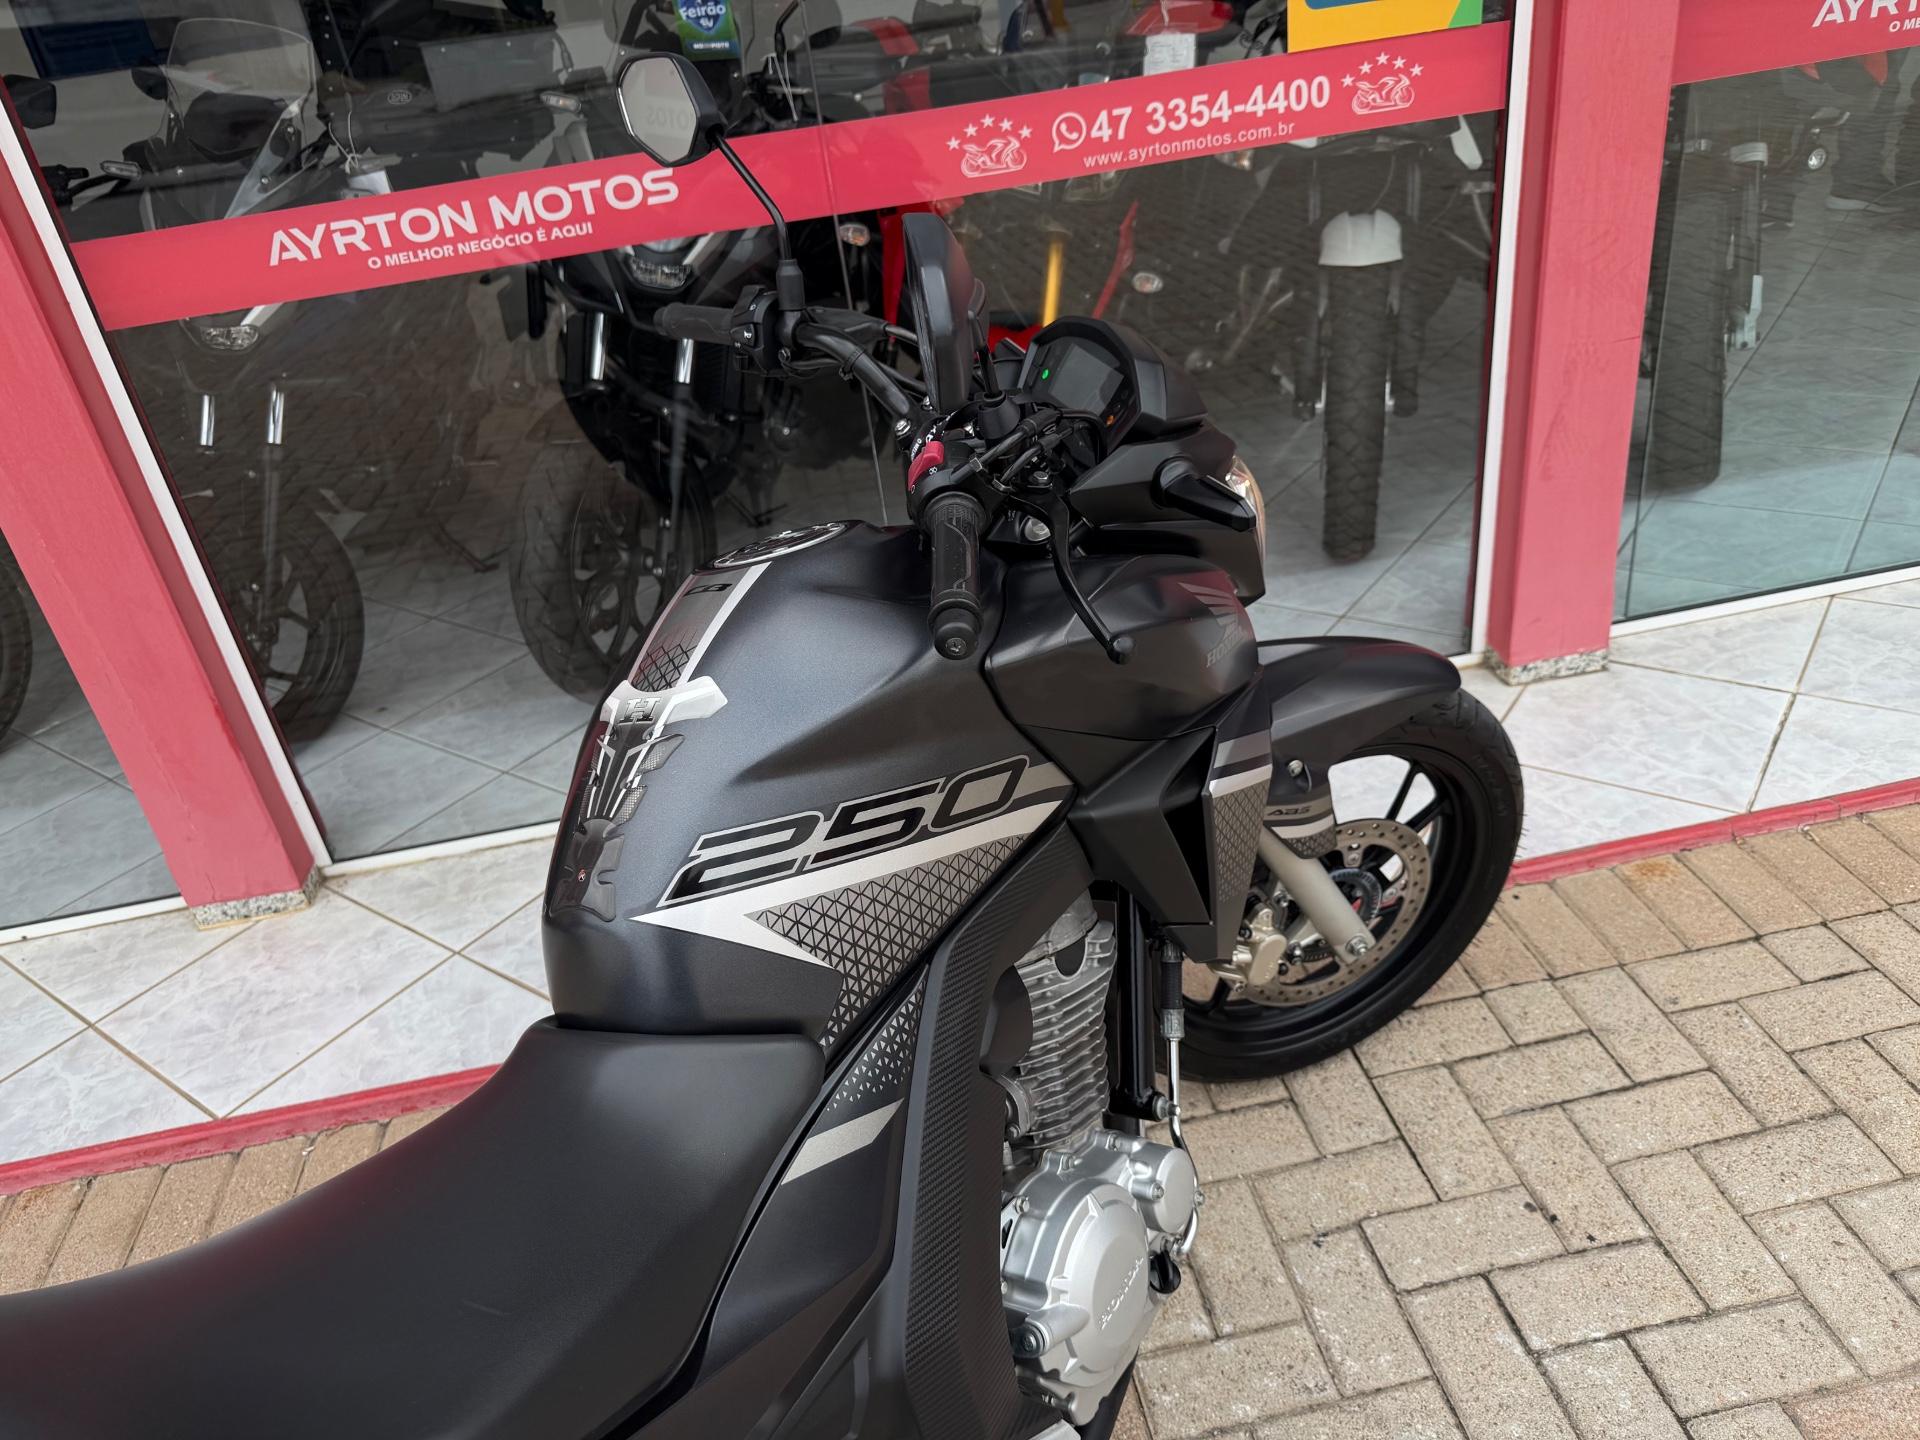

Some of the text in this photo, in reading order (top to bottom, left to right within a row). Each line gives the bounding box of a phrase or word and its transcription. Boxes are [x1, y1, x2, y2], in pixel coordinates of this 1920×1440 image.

[679, 2, 726, 20] Feirão
[1889, 21, 1901, 32] O
[1090, 75, 1331, 143] 47 3354-4400
[1083, 121, 1295, 169] www.ayrtonmotos.com.br
[269, 168, 680, 266] AYRTON MOTOS
[367, 221, 593, 270] O MELHOR NEGÓCIO É AQUI
[618, 697, 662, 725] H
[656, 754, 1030, 908] 250
